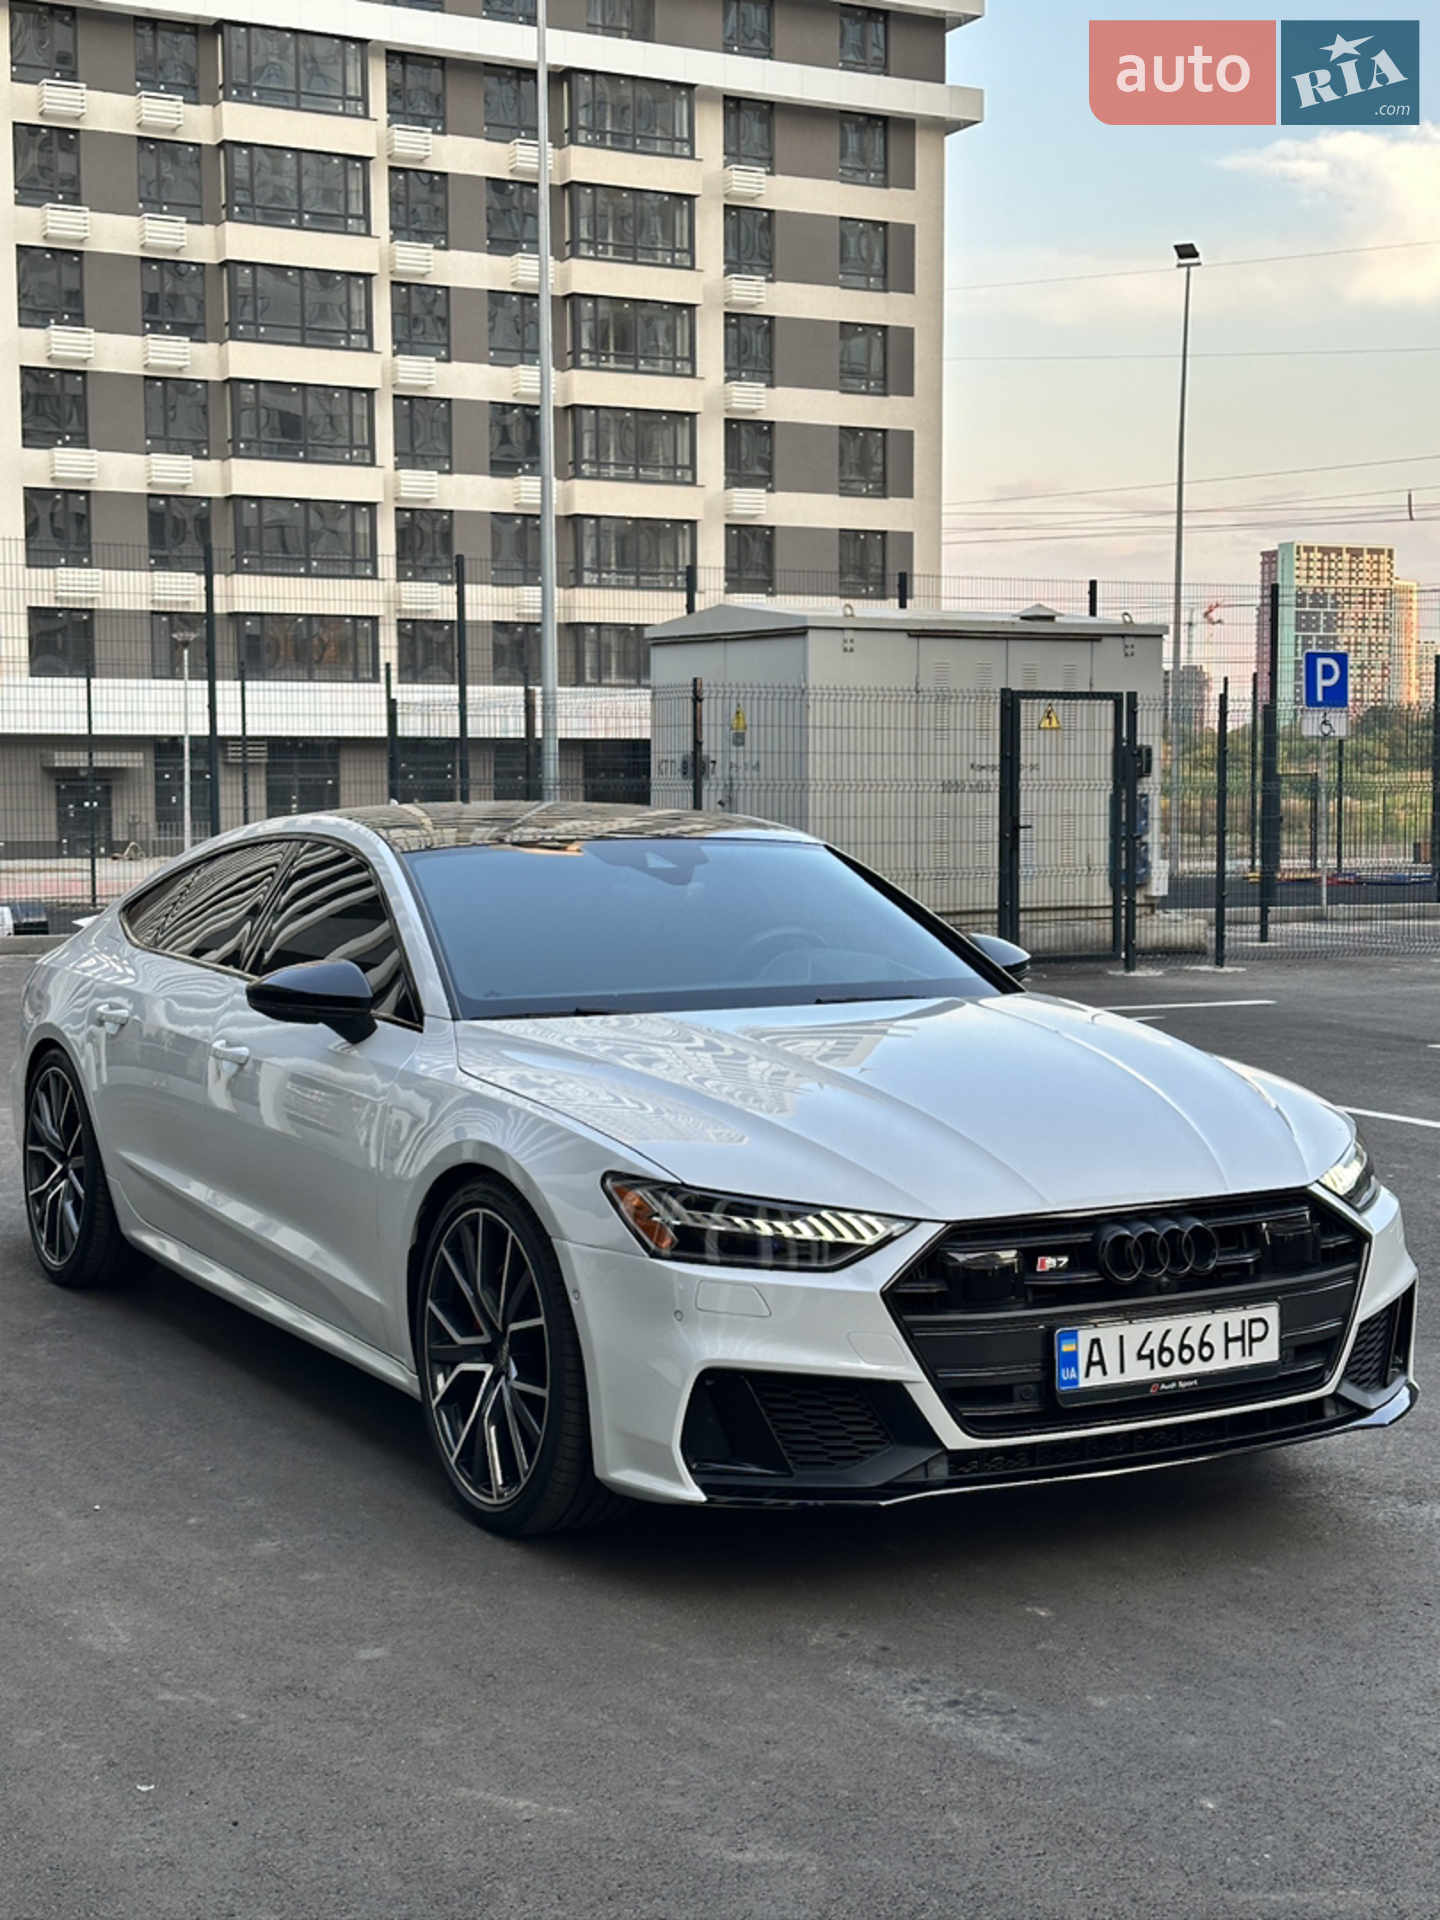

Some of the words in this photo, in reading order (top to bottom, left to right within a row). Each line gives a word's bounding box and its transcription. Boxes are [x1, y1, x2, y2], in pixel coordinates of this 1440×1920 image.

[1316, 657, 1341, 702] P
[1084, 1335, 1125, 1379] AI
[1136, 1323, 1215, 1370] 4666
[1224, 1317, 1270, 1360] HP
[1061, 1367, 1078, 1381] UA
[1160, 1381, 1177, 1391] Audi
[1178, 1378, 1199, 1389] Sport
